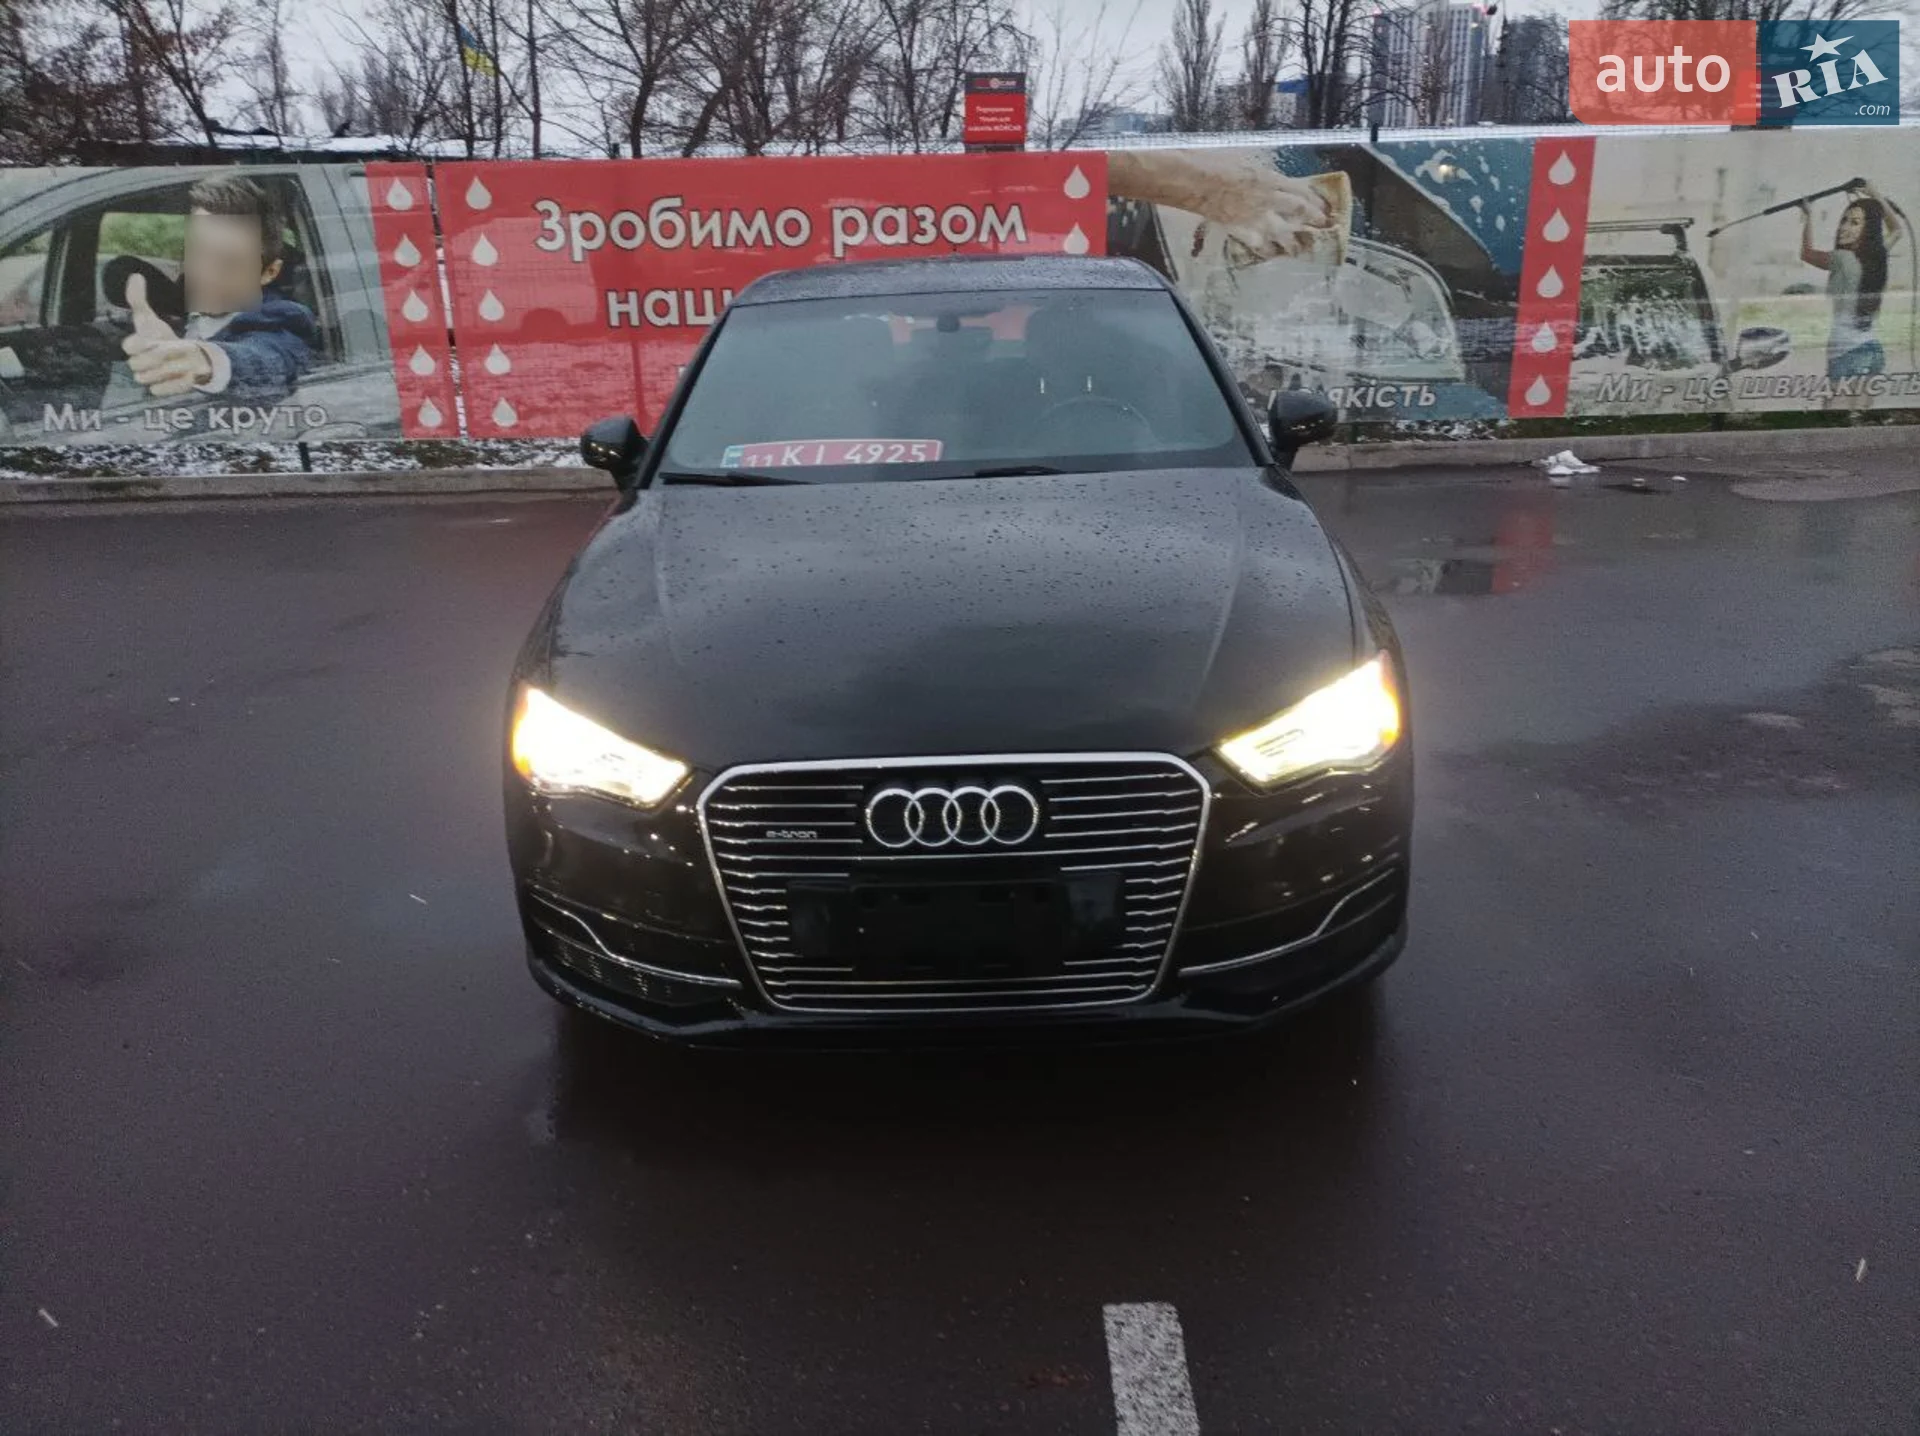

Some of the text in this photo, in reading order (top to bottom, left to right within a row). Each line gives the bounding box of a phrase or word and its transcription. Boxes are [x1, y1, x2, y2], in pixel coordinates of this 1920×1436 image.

[534, 197, 1028, 262] Зробимо разом
[1597, 374, 1650, 401] Ми
[1683, 378, 1729, 403] це
[43, 402, 101, 431] Ми
[143, 407, 195, 433] це
[208, 404, 328, 435] круто
[843, 443, 929, 463] 4925
[766, 829, 817, 838] e-tron
